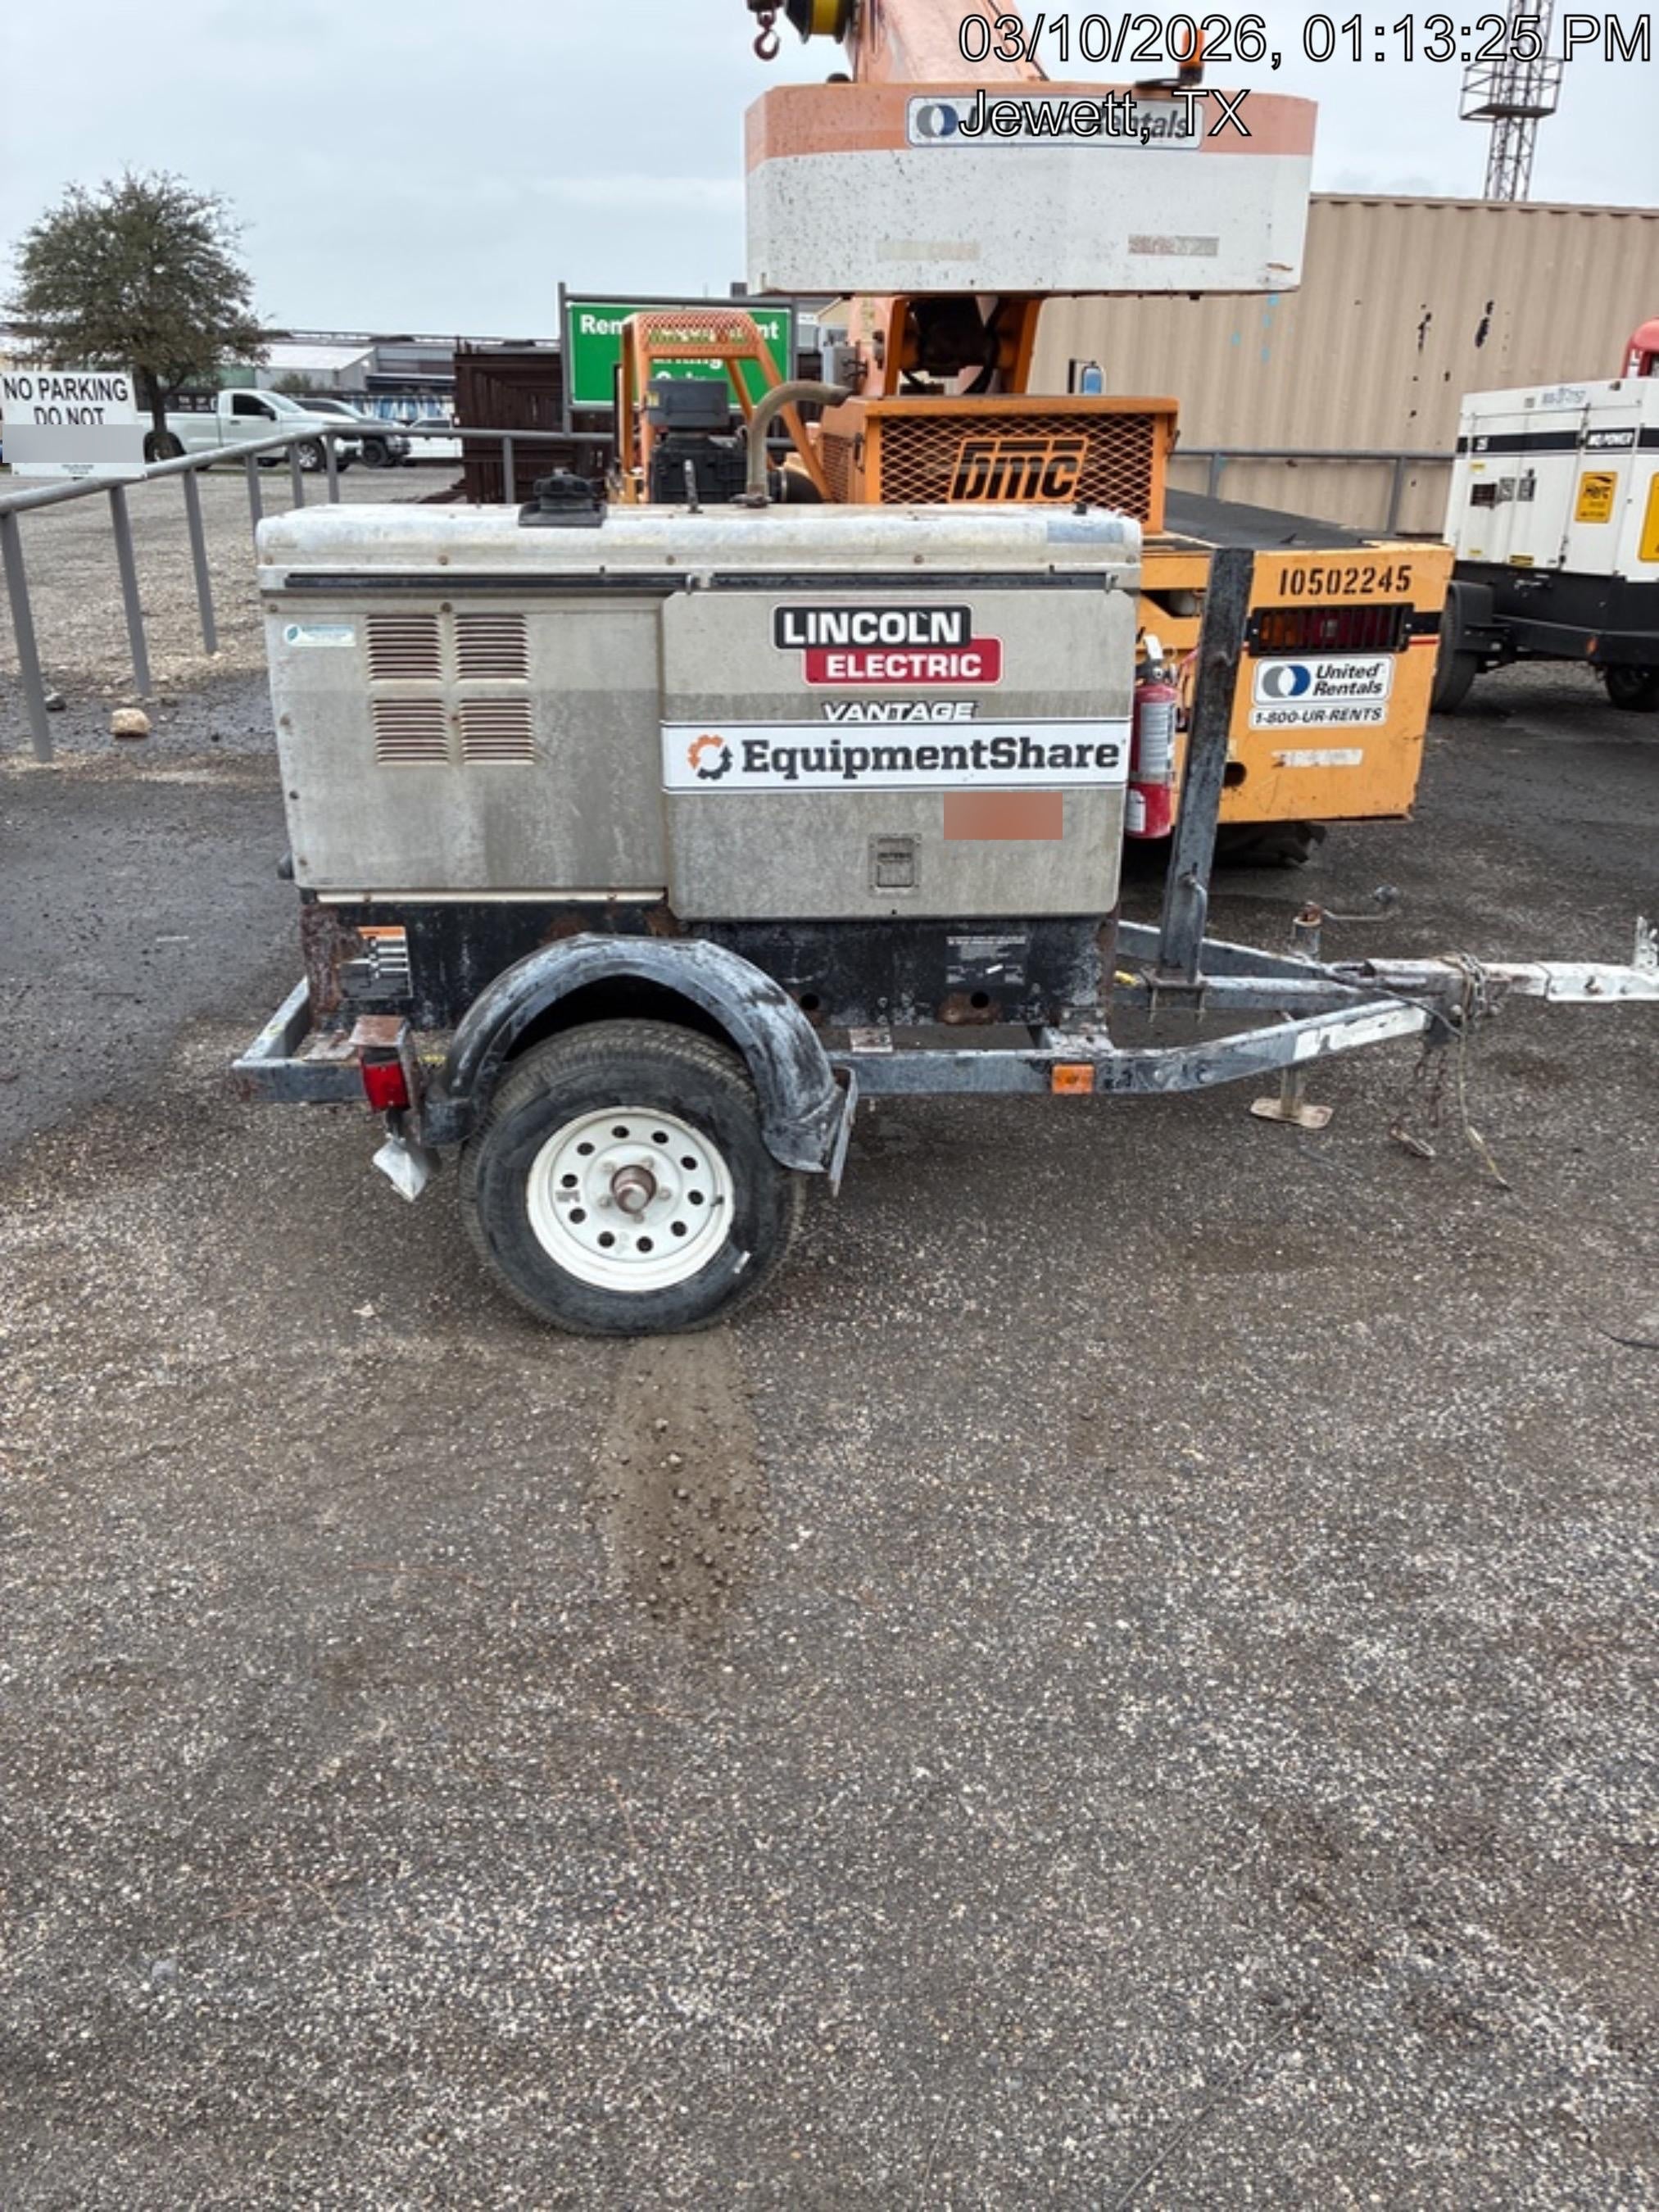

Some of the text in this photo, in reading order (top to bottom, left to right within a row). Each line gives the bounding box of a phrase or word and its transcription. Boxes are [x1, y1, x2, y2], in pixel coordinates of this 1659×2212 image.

[3, 378, 129, 401] NO PARKING
[34, 406, 106, 425] DO NOT
[1279, 564, 1412, 596] 10502245
[783, 611, 963, 645] LINCOLN
[826, 653, 982, 678] ELECTRIC
[1316, 663, 1382, 679] United
[1312, 680, 1383, 696] Rentals
[821, 700, 977, 721] VANTAGE
[1255, 707, 1382, 724] 1-800-UR-RENTS
[741, 737, 1120, 780] EquipmentShare
